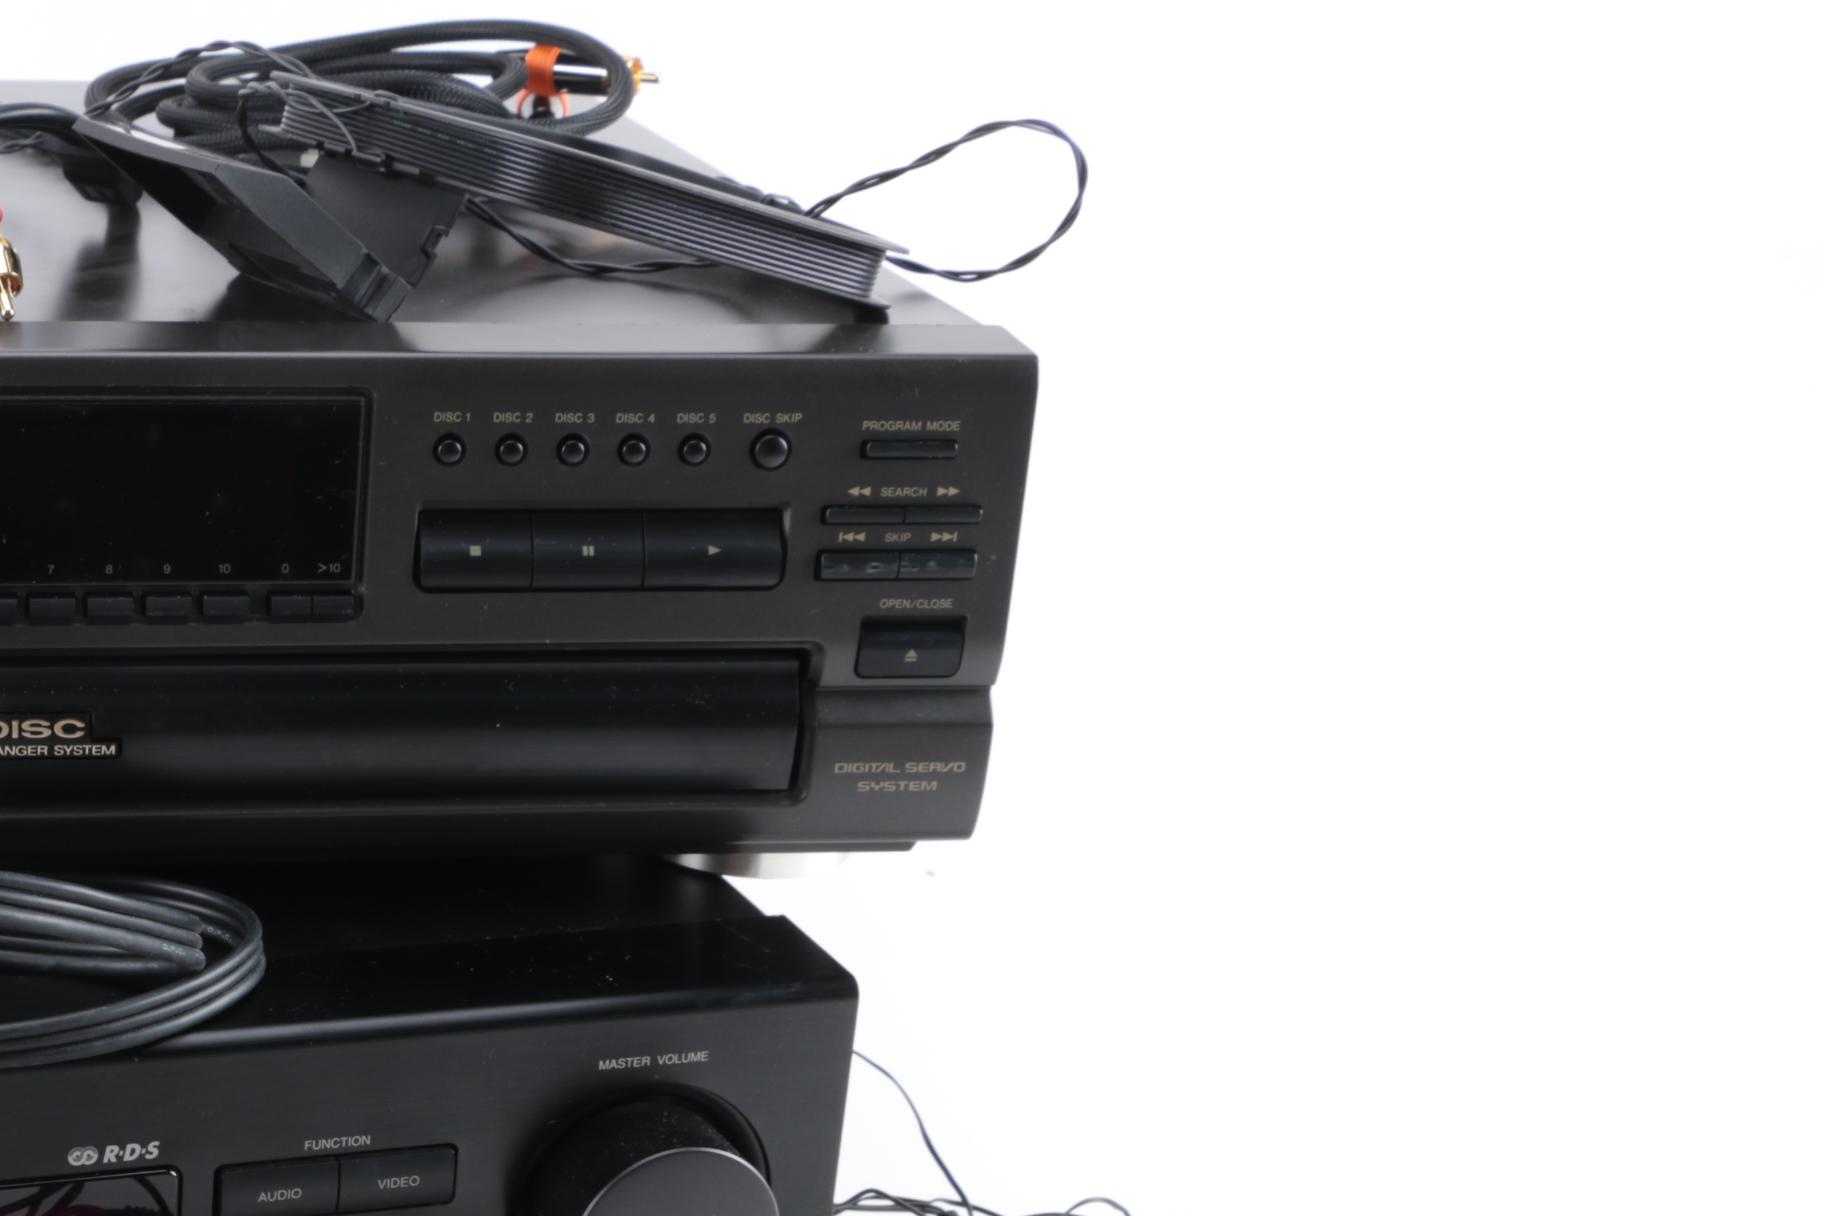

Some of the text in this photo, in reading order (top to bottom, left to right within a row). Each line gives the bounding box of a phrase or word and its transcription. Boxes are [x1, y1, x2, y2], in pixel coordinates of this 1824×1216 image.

[433, 412, 471, 423] DISC 1
[493, 412, 533, 423] DISC 2
[555, 413, 595, 423] DISC 3
[616, 413, 655, 423] DISC 4
[677, 413, 716, 423] DISC 5
[743, 413, 802, 423] DISC SKIP
[862, 421, 960, 431] PROGRAM MODE
[881, 487, 927, 497] SEARCH
[885, 532, 911, 542] SKIP
[880, 599, 953, 609] OPEN/CLOSE
[54, 745, 115, 756] SYSTEM
[834, 762, 966, 773] DIGITAL SERVO
[857, 781, 938, 792] SYSTEM
[598, 1050, 710, 1071] MASTER VOLUME
[304, 1135, 371, 1151] FUNCTION
[376, 1175, 420, 1190] VIDEO
[257, 1187, 302, 1203] AUDIO
